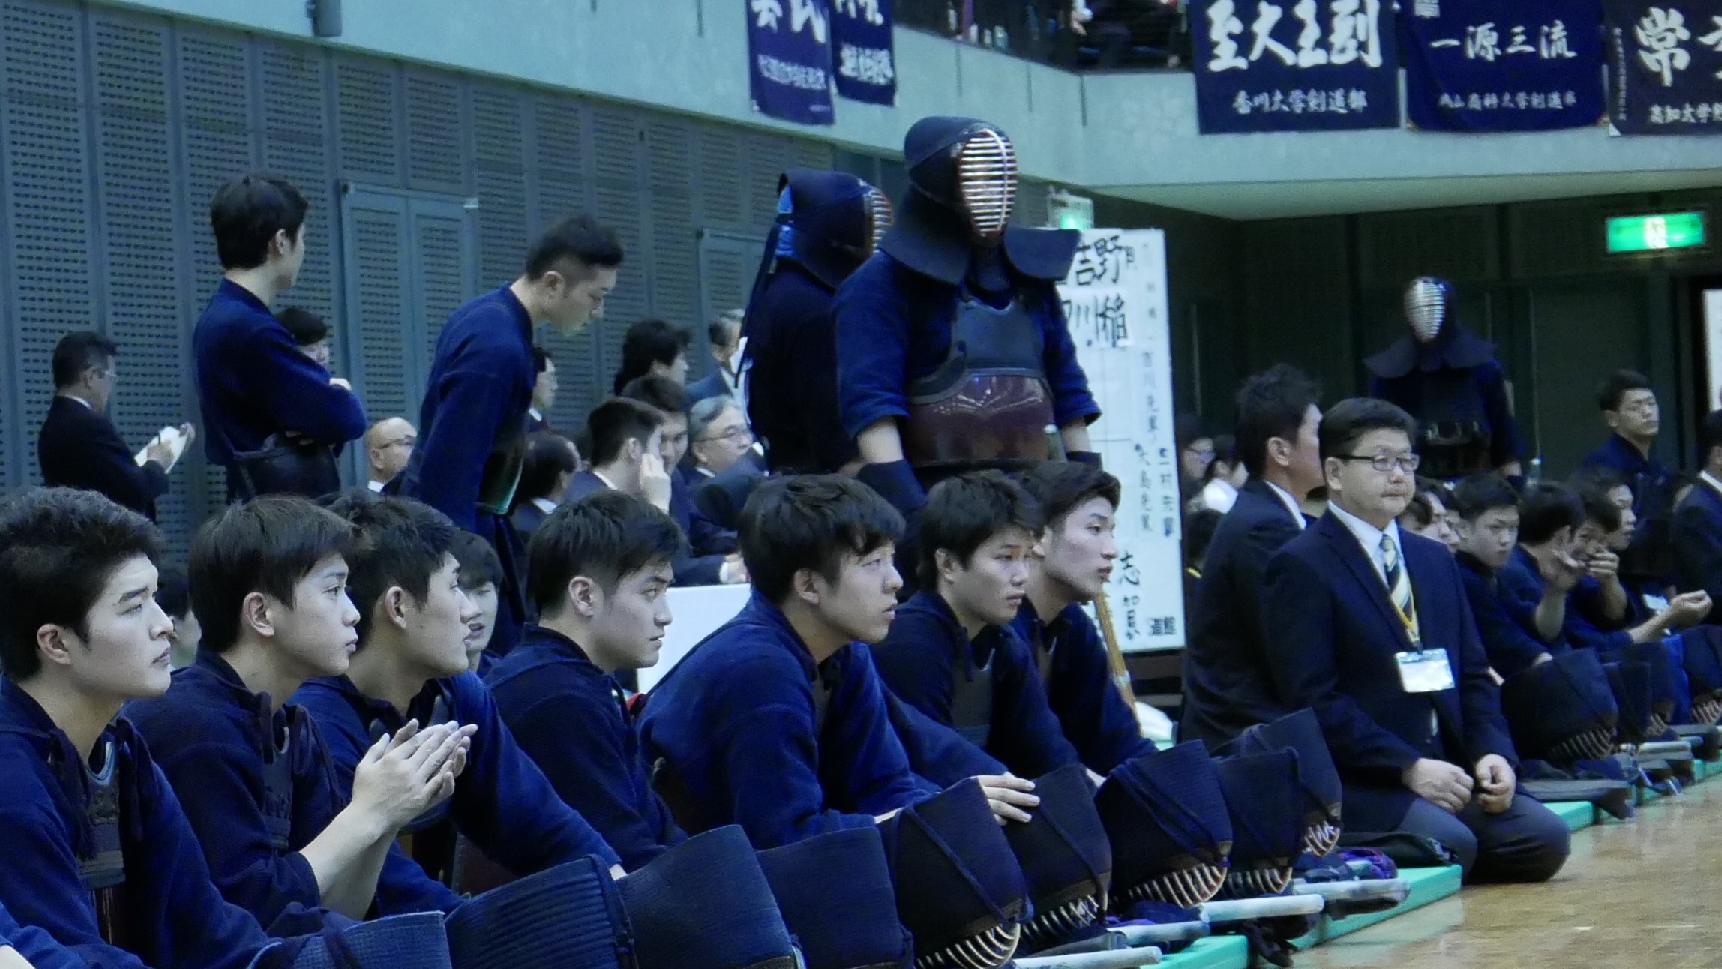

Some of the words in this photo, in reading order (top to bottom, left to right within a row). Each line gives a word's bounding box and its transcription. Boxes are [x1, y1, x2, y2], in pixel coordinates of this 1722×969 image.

[1431, 19, 1578, 62] 一源三流
[1635, 6, 1722, 87] 常
